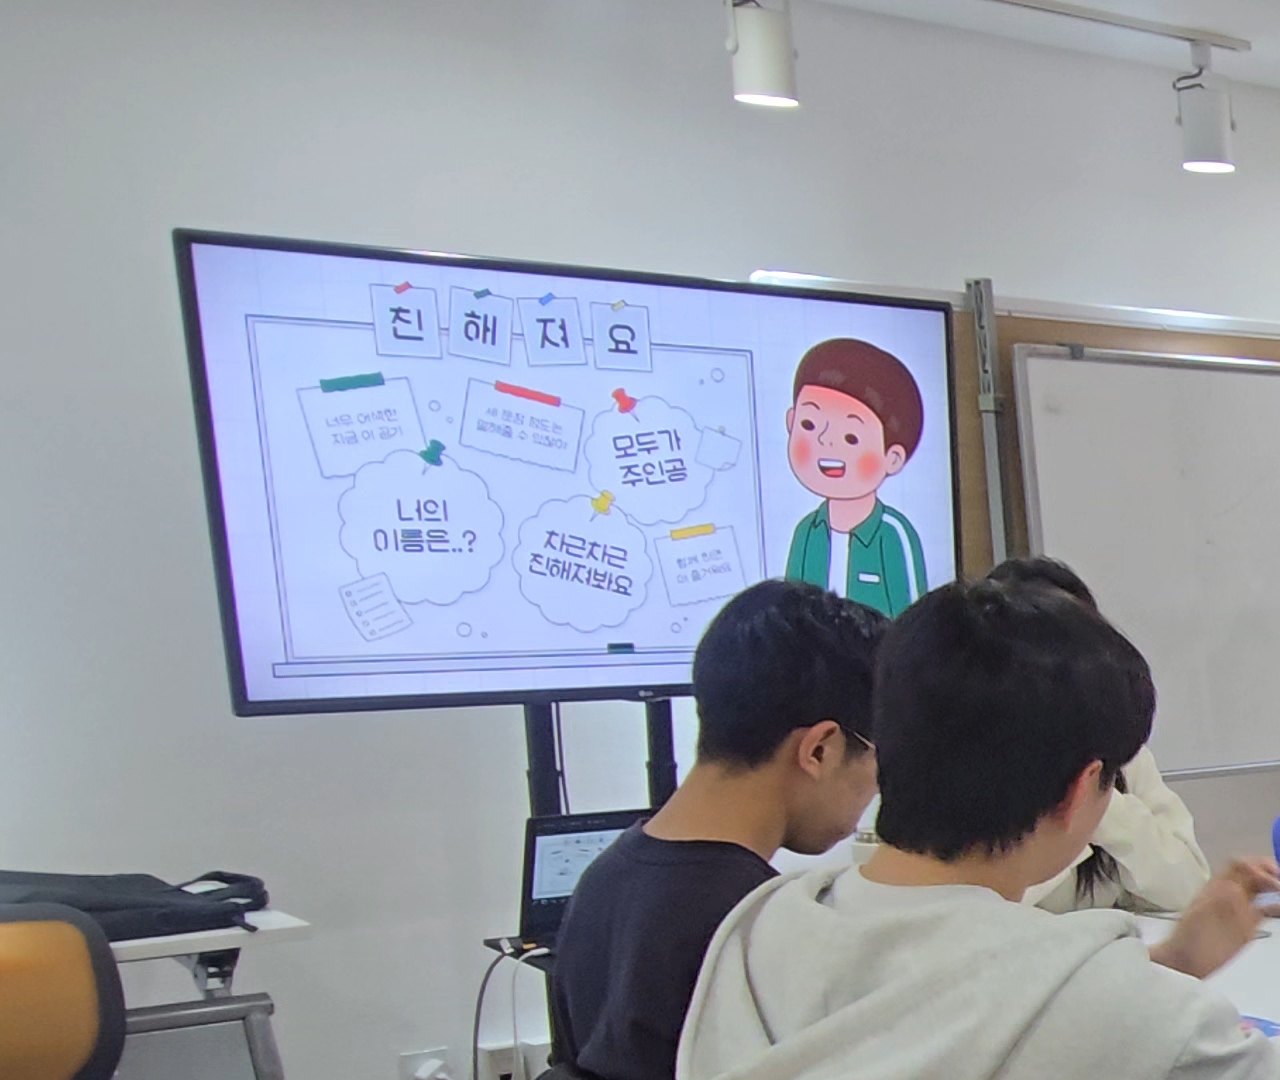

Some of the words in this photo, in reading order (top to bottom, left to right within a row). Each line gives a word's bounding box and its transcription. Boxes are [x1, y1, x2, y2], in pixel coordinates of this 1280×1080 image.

[361, 430, 375, 441] 이
[612, 428, 681, 459] 모두가
[619, 458, 688, 487] 주인공
[396, 498, 449, 522] 너의
[373, 528, 477, 553] 이름은..?
[543, 530, 628, 570] 차근차근
[528, 552, 633, 597] 친해져봐요
